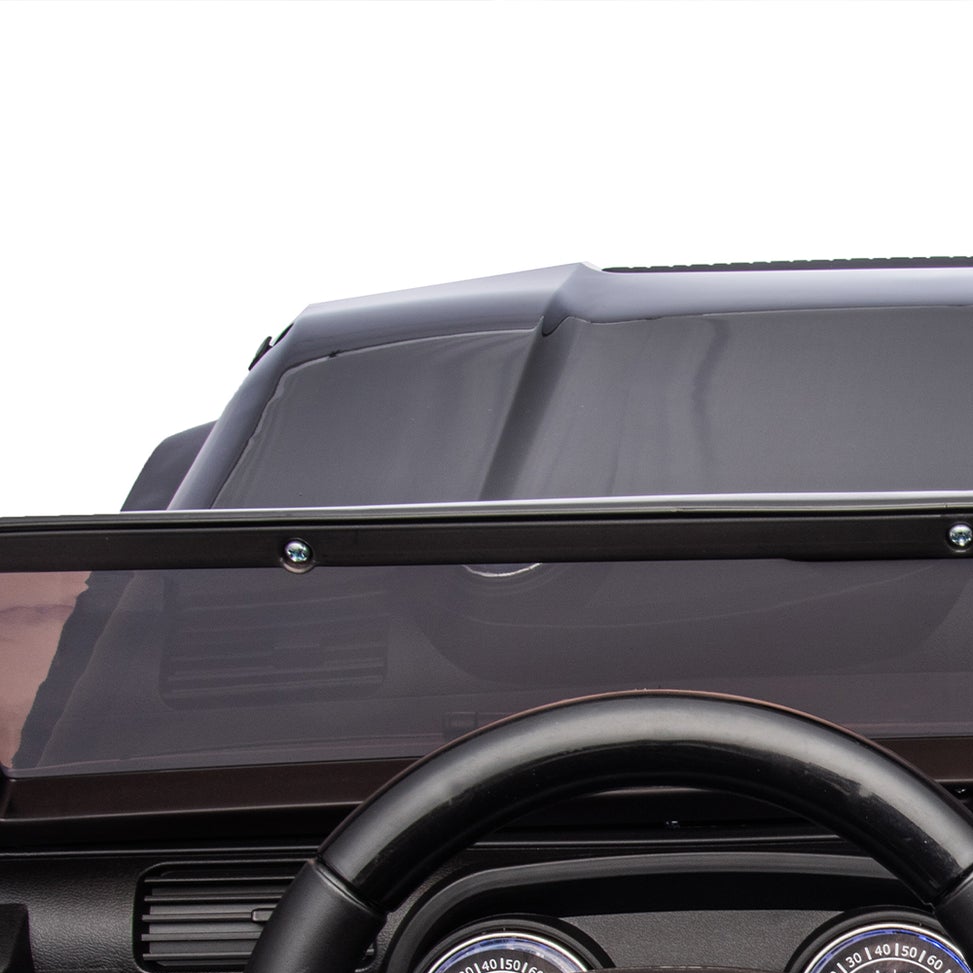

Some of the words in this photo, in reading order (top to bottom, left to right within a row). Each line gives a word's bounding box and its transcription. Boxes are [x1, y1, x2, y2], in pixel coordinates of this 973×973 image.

[874, 943, 891, 956] 40
[901, 945, 918, 959] 50
[481, 958, 498, 971] 40
[505, 959, 521, 972] 50
[845, 952, 862, 968] 30
[926, 954, 943, 971] 60
